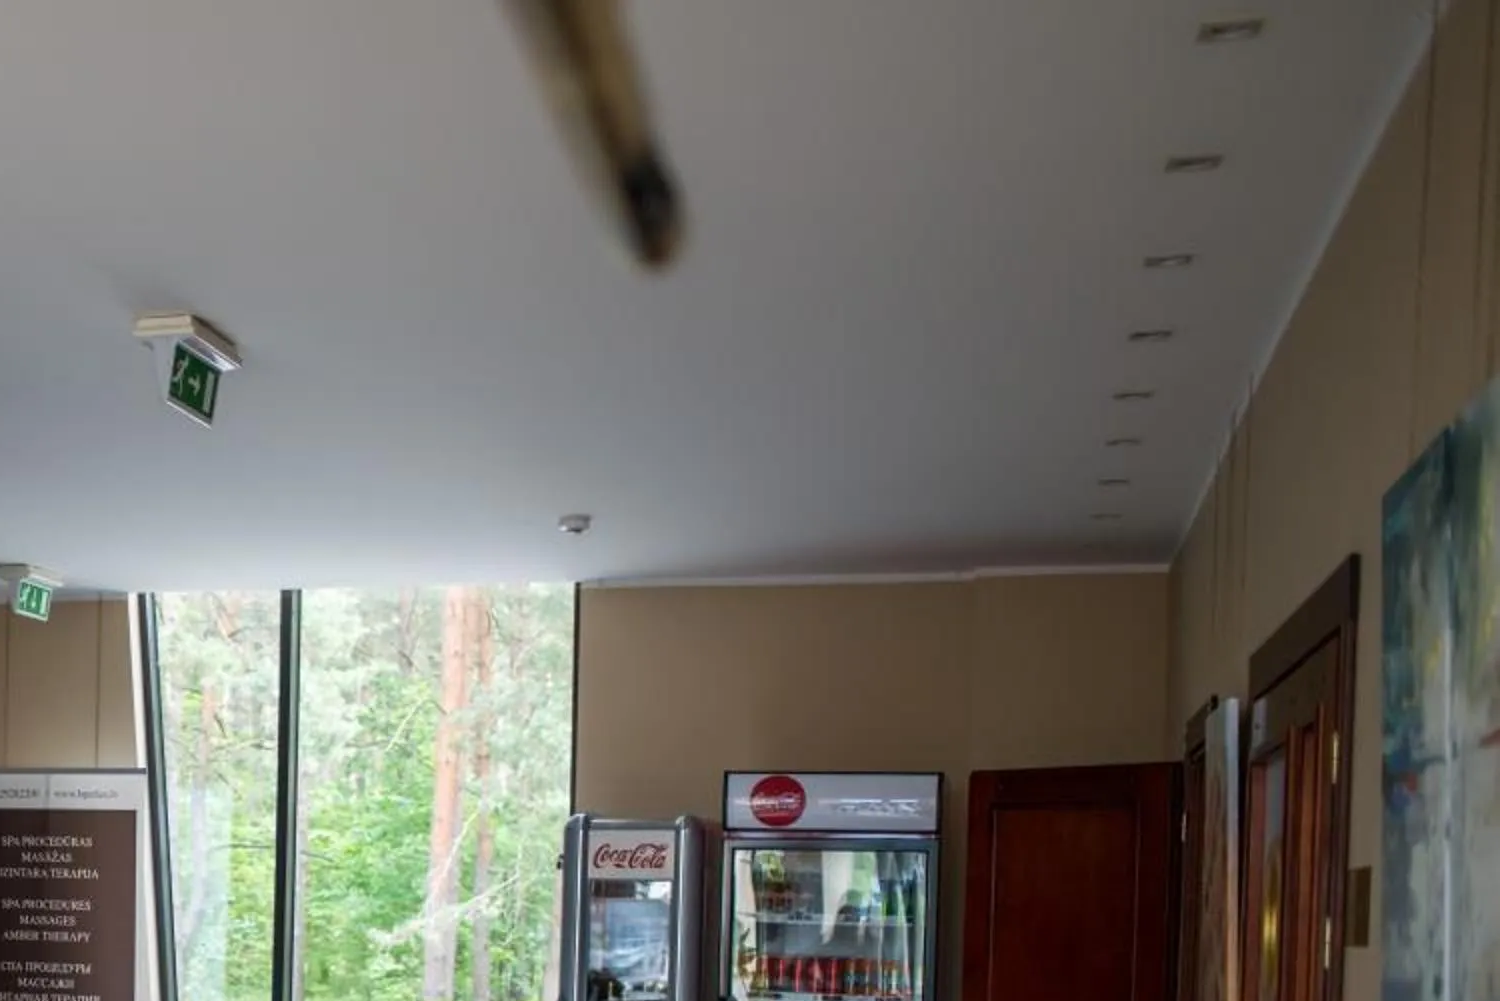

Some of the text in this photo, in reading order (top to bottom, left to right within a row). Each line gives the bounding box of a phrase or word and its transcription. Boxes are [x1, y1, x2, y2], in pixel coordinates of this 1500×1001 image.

[1, 835, 20, 847] SPA
[593, 843, 668, 869] Coca-Cola
[19, 914, 77, 927] MASSAGES
